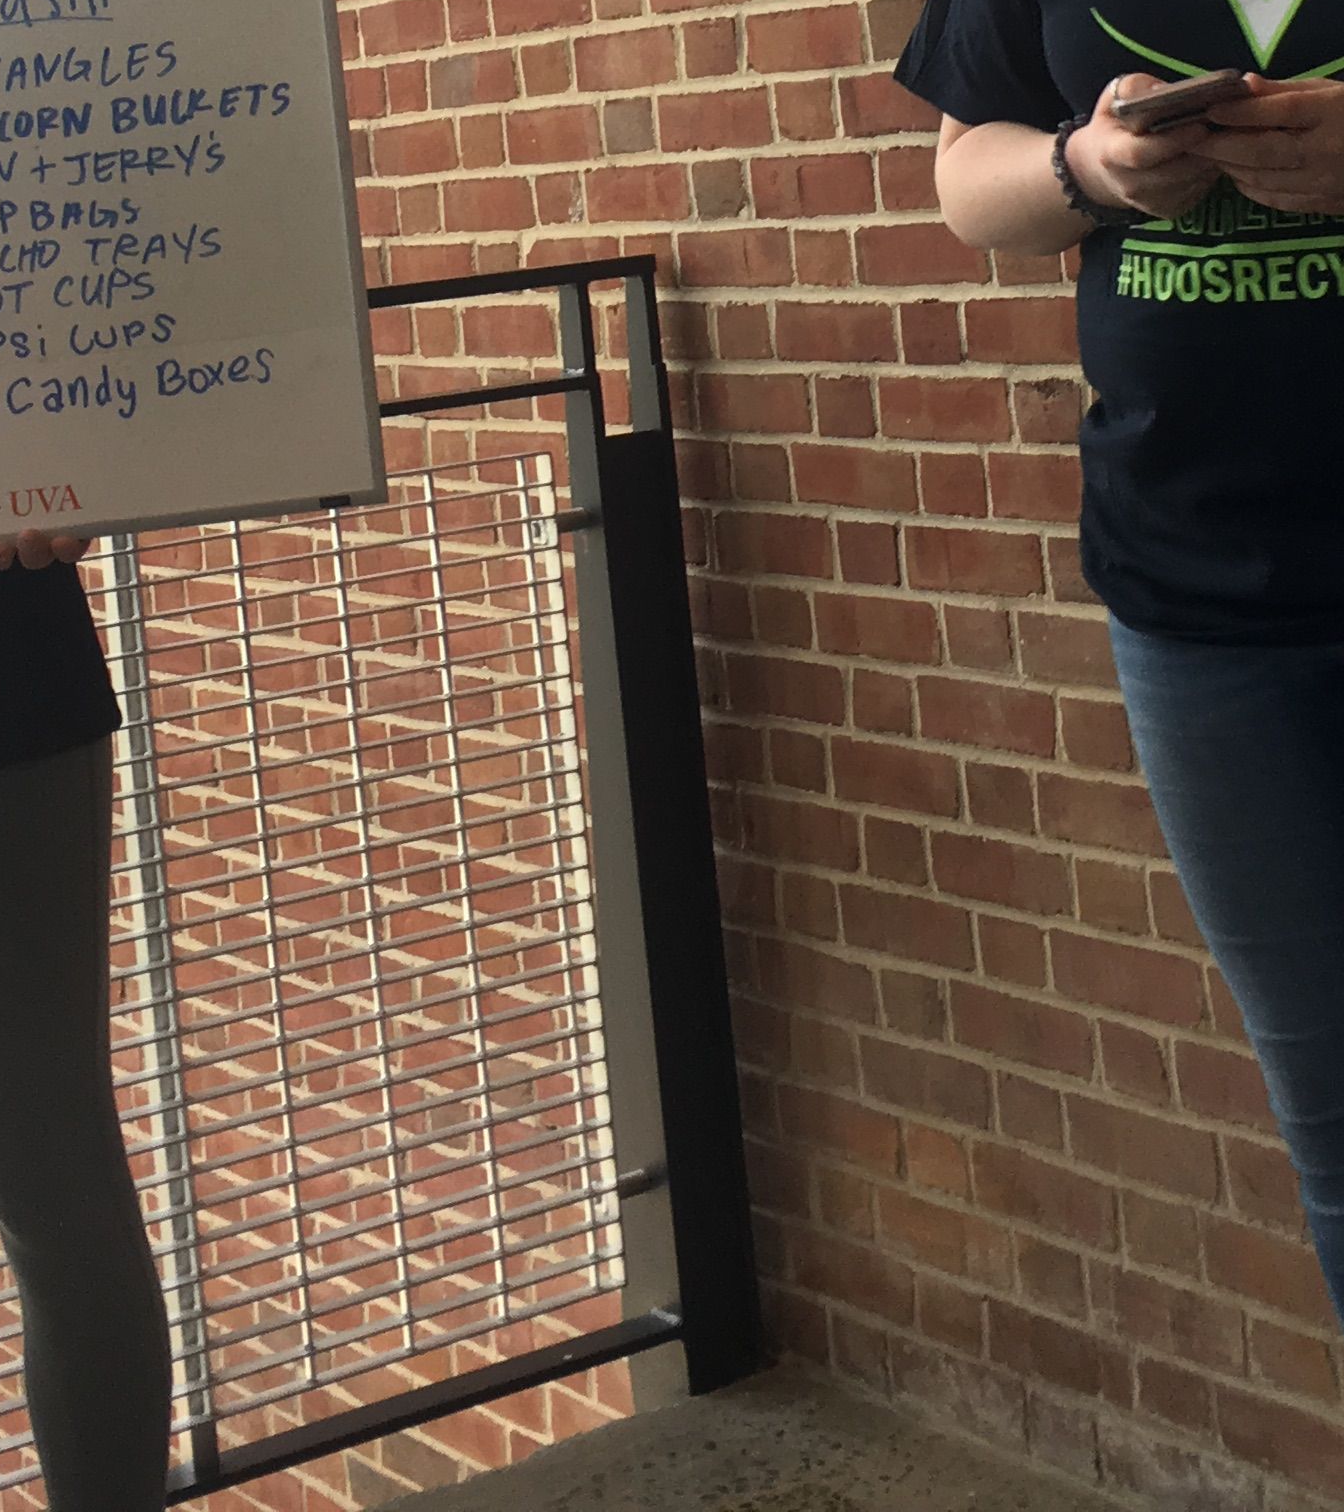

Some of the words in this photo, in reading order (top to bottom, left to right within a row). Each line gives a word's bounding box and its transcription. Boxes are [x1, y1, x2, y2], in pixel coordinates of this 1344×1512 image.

[110, 82, 292, 134] BUCKETS
[29, 197, 143, 233] BAGS
[84, 223, 223, 266] TRAYS
[53, 267, 156, 310] CUPS
[8, 484, 83, 519] UVA
